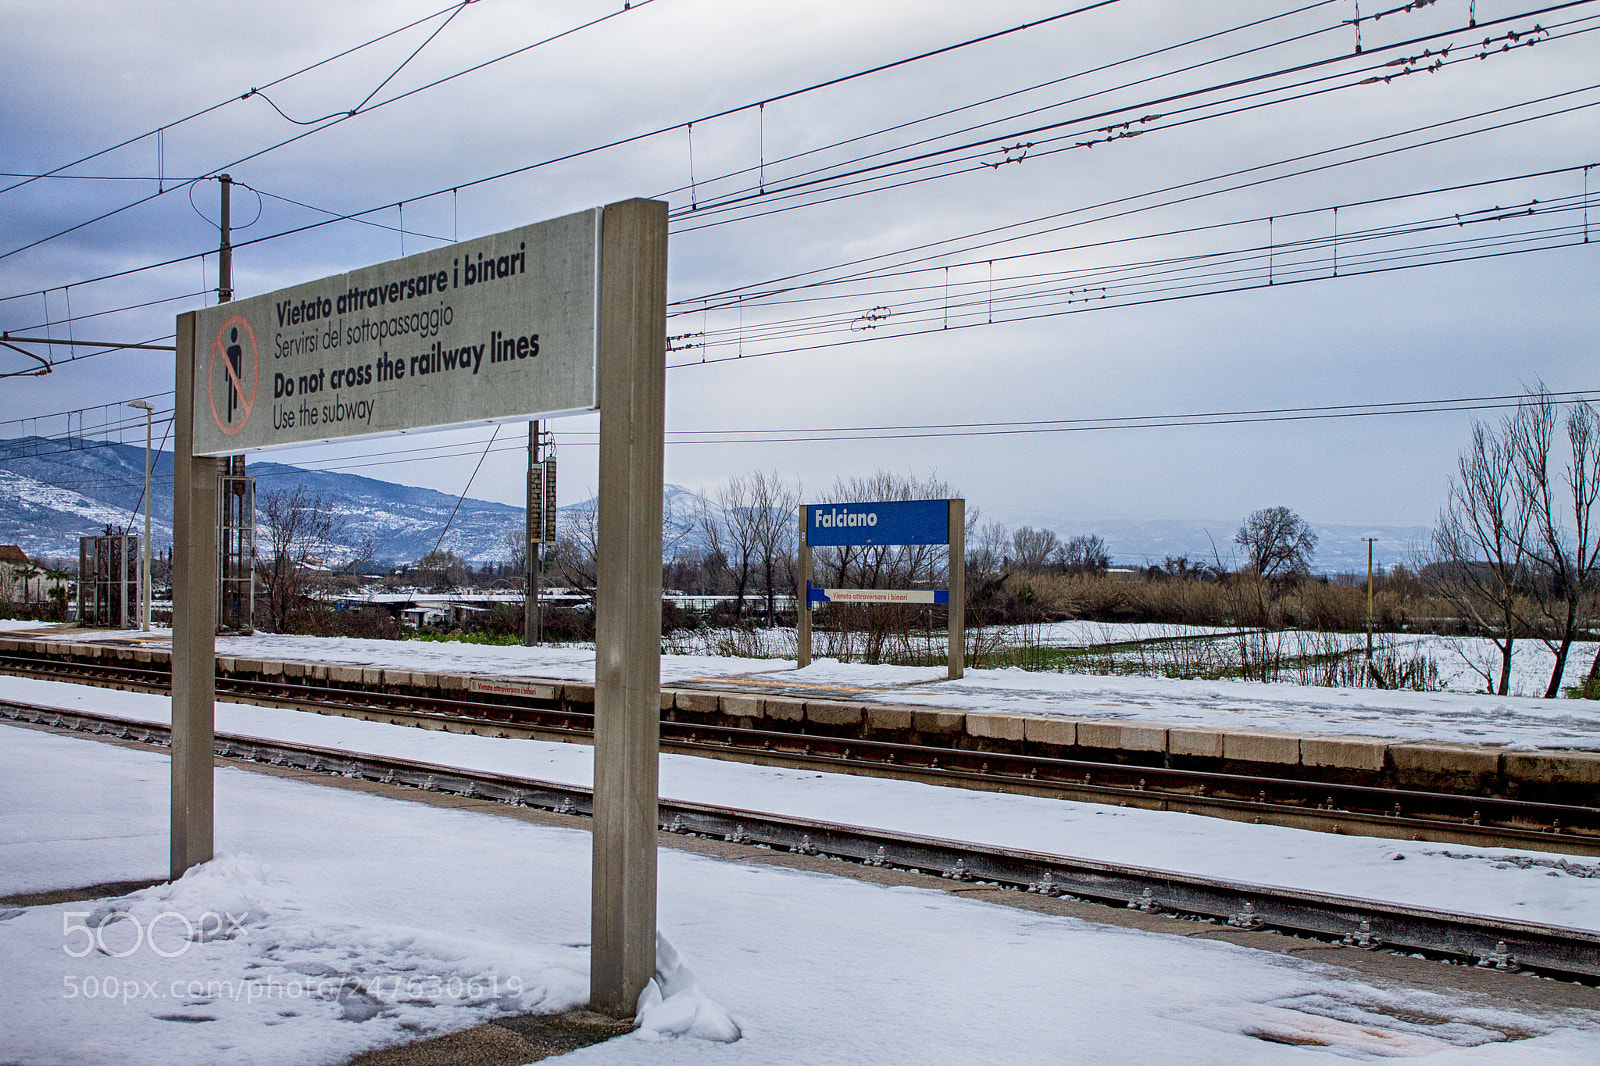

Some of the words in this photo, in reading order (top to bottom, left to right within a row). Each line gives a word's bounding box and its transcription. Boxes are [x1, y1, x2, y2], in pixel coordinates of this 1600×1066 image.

[276, 297, 331, 328] Vietato
[337, 270, 447, 315] attraversare
[464, 242, 526, 285] binari
[275, 327, 318, 359] Servirsi
[322, 322, 342, 350] del
[346, 301, 454, 346] sottopassaggio
[274, 372, 294, 398] Do
[299, 368, 324, 393] not
[330, 363, 372, 389] cross
[377, 352, 405, 382] the
[410, 337, 485, 375] railway
[491, 330, 540, 363] lines
[273, 403, 295, 430] Use
[299, 398, 318, 426] the
[322, 394, 375, 426] subway
[815, 508, 877, 527] Falciano
